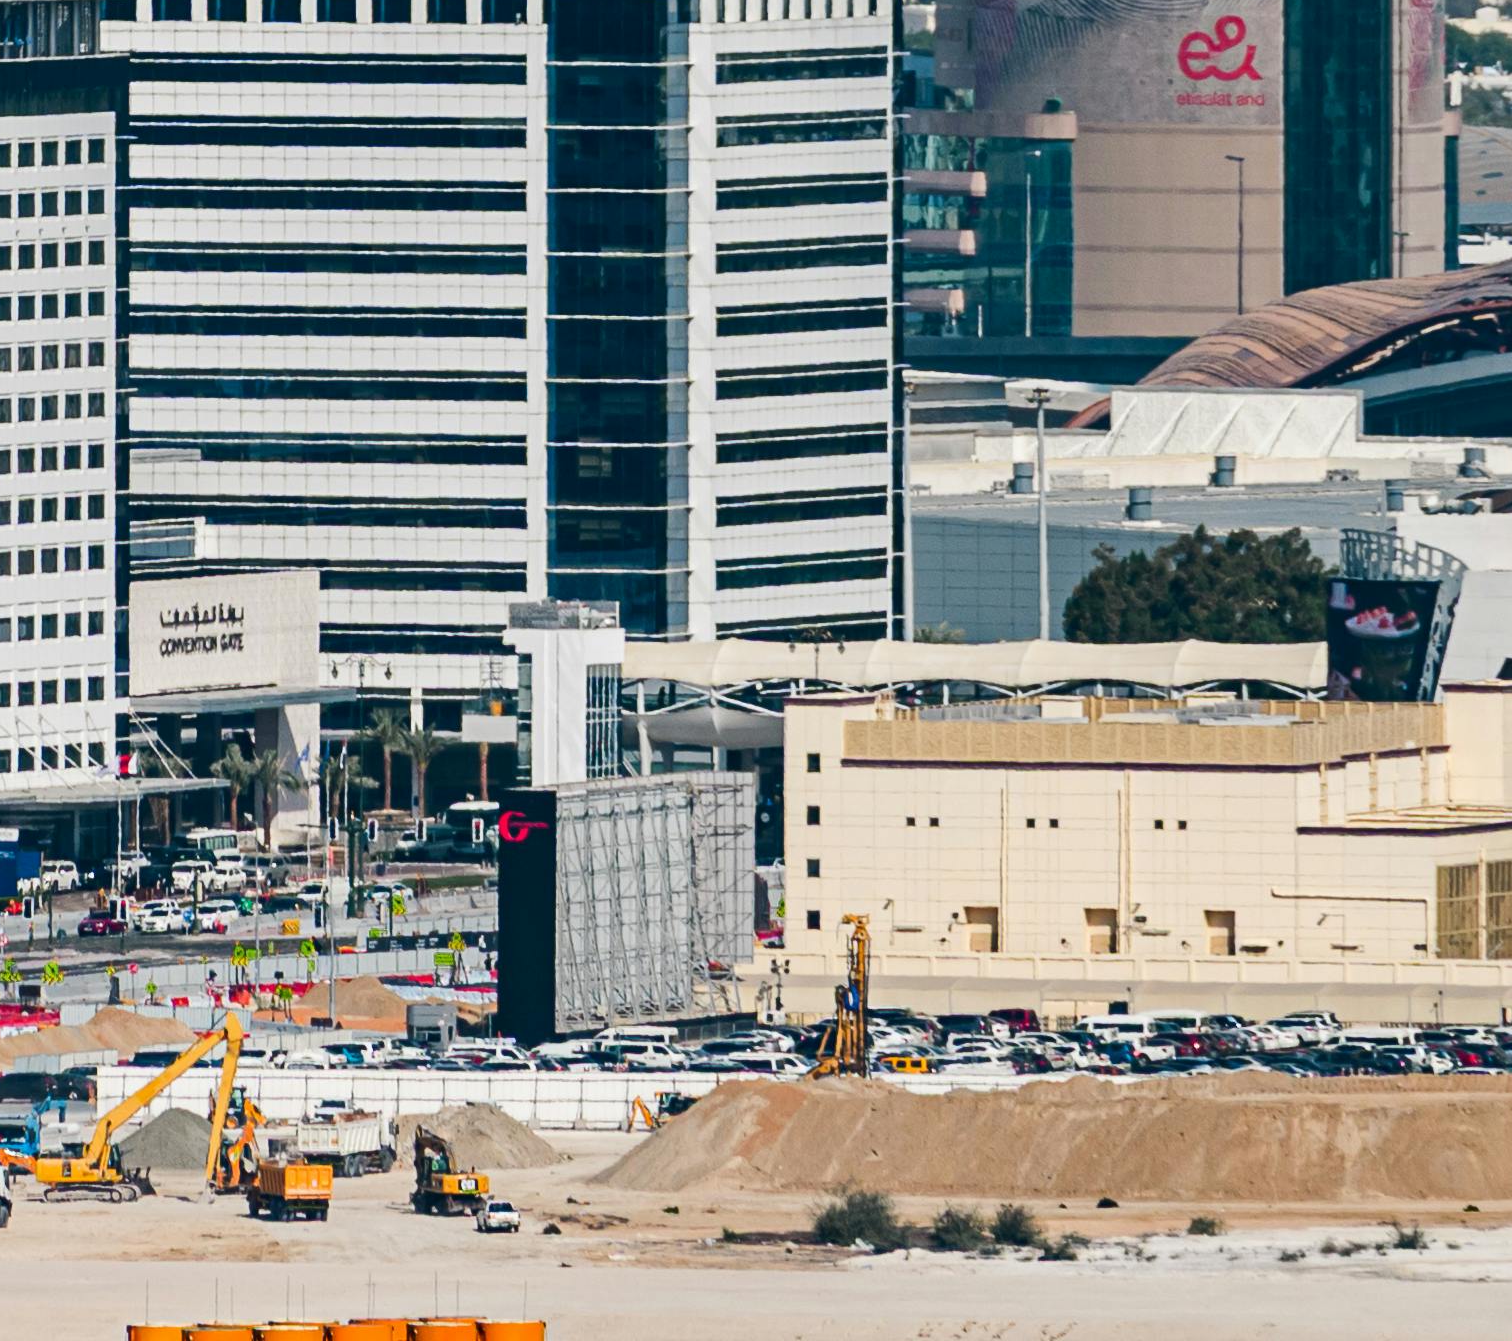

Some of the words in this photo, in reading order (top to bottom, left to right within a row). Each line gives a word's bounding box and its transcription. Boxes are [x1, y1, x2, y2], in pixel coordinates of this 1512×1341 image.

[1236, 93, 1264, 106] and
[160, 636, 217, 657] CONVENTION
[220, 633, 243, 653] GATE
